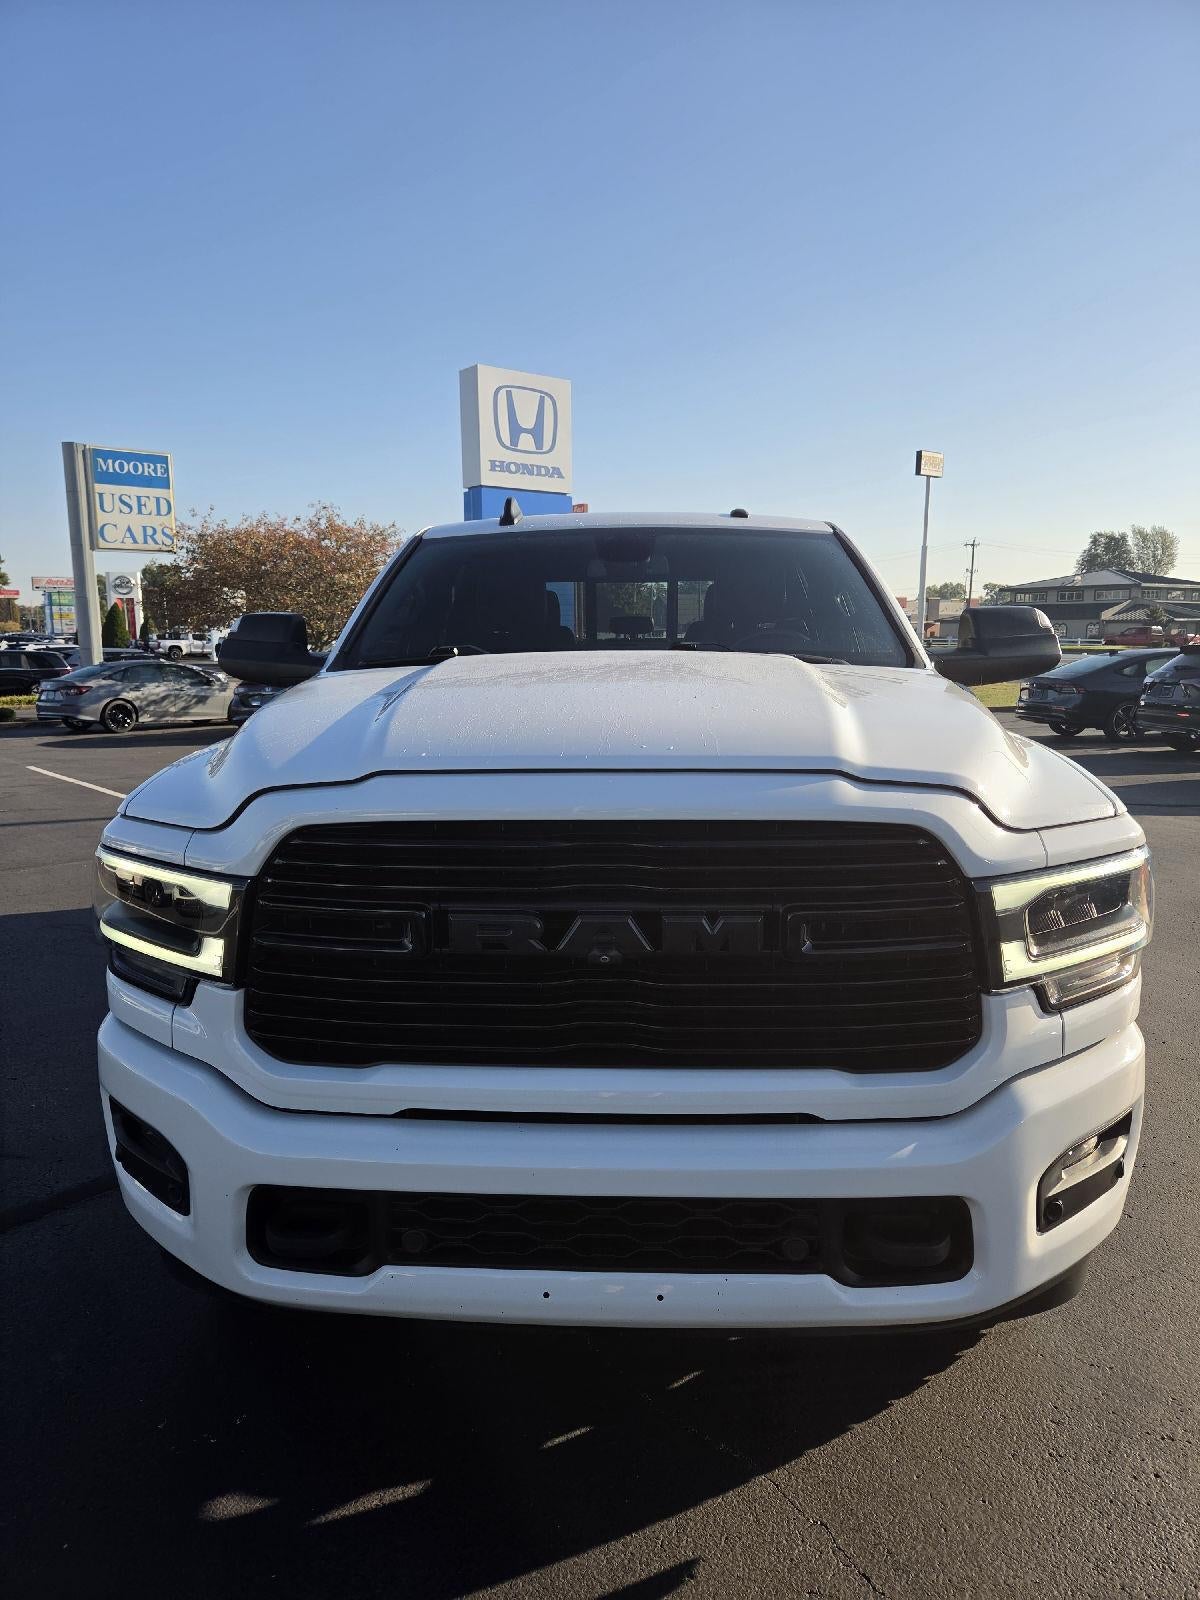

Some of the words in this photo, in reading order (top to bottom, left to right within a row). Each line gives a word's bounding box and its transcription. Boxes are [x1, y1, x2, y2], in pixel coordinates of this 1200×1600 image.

[96, 457, 168, 477] MOORE
[488, 459, 565, 479] HONDA
[97, 492, 172, 516] USED
[98, 522, 175, 547] CARS
[449, 909, 765, 951] RAM
